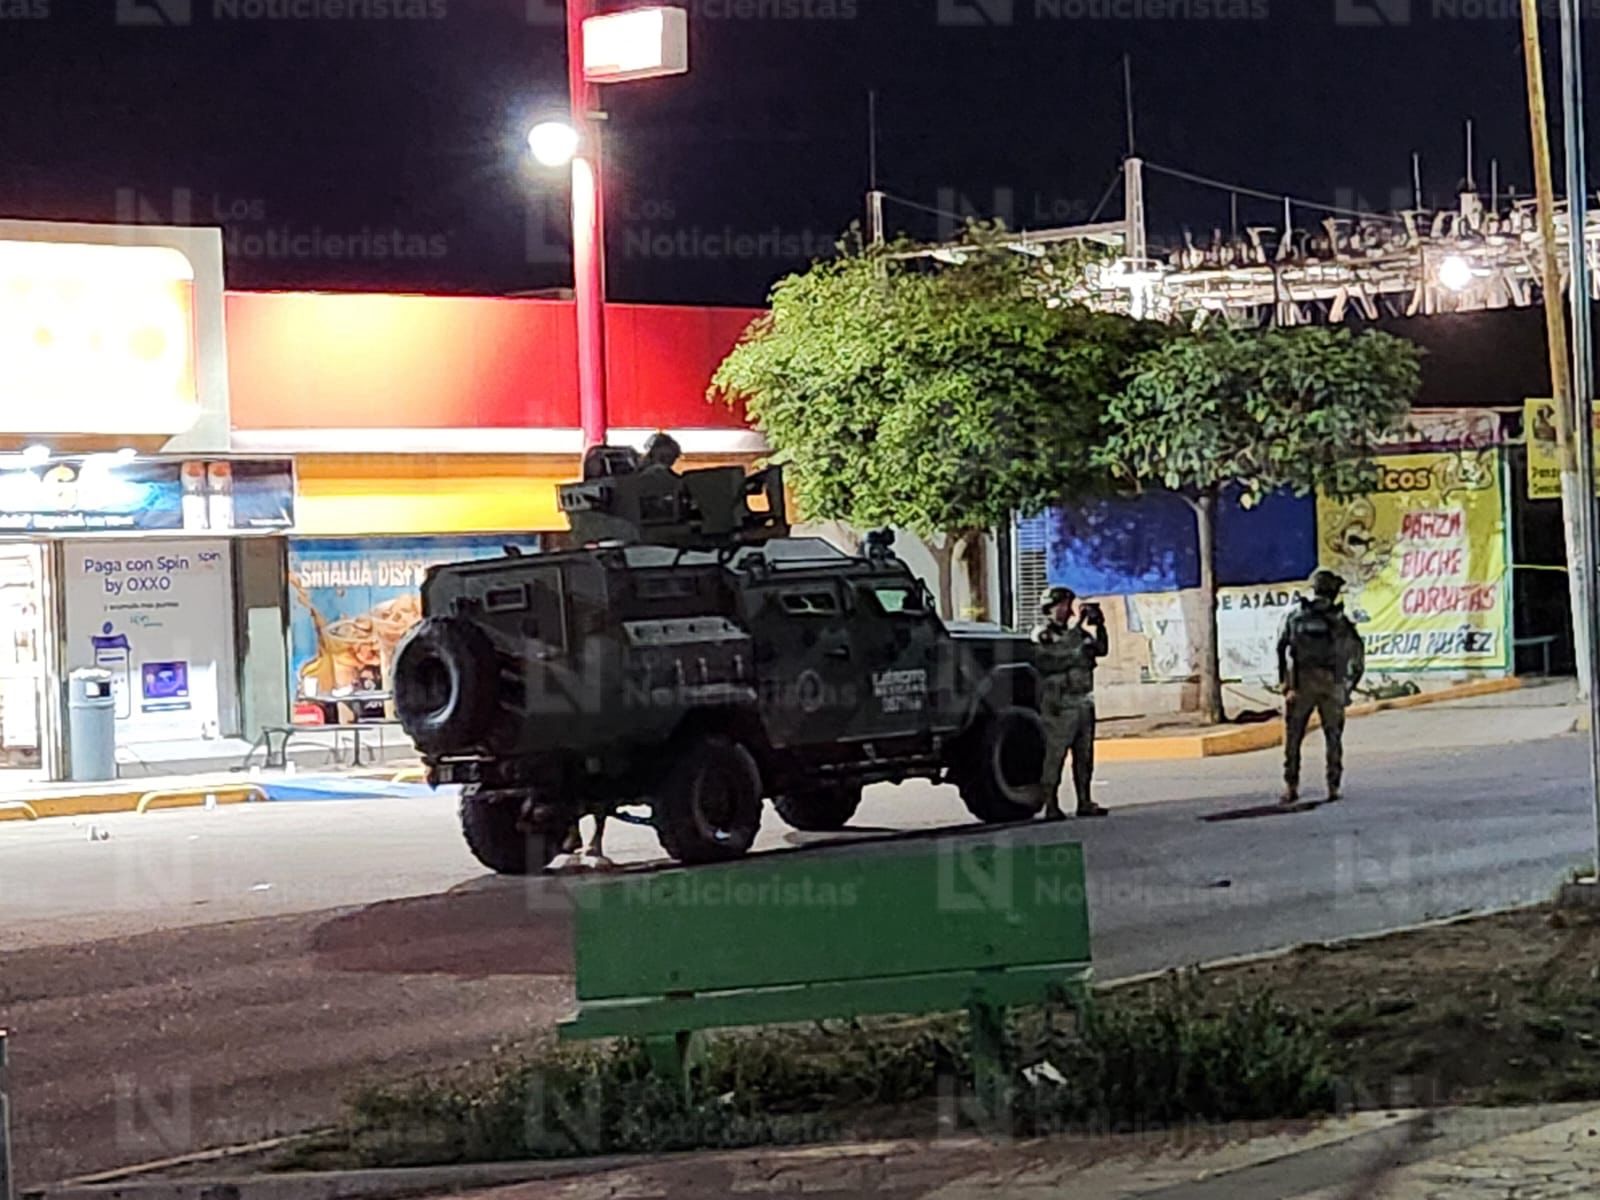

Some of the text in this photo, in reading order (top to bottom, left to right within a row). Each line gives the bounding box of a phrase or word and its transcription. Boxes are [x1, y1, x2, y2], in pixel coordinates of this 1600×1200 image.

[84, 554, 189, 576] Paga con Spin
[105, 576, 171, 595] by OXXO
[1362, 632, 1422, 656] UERIA
